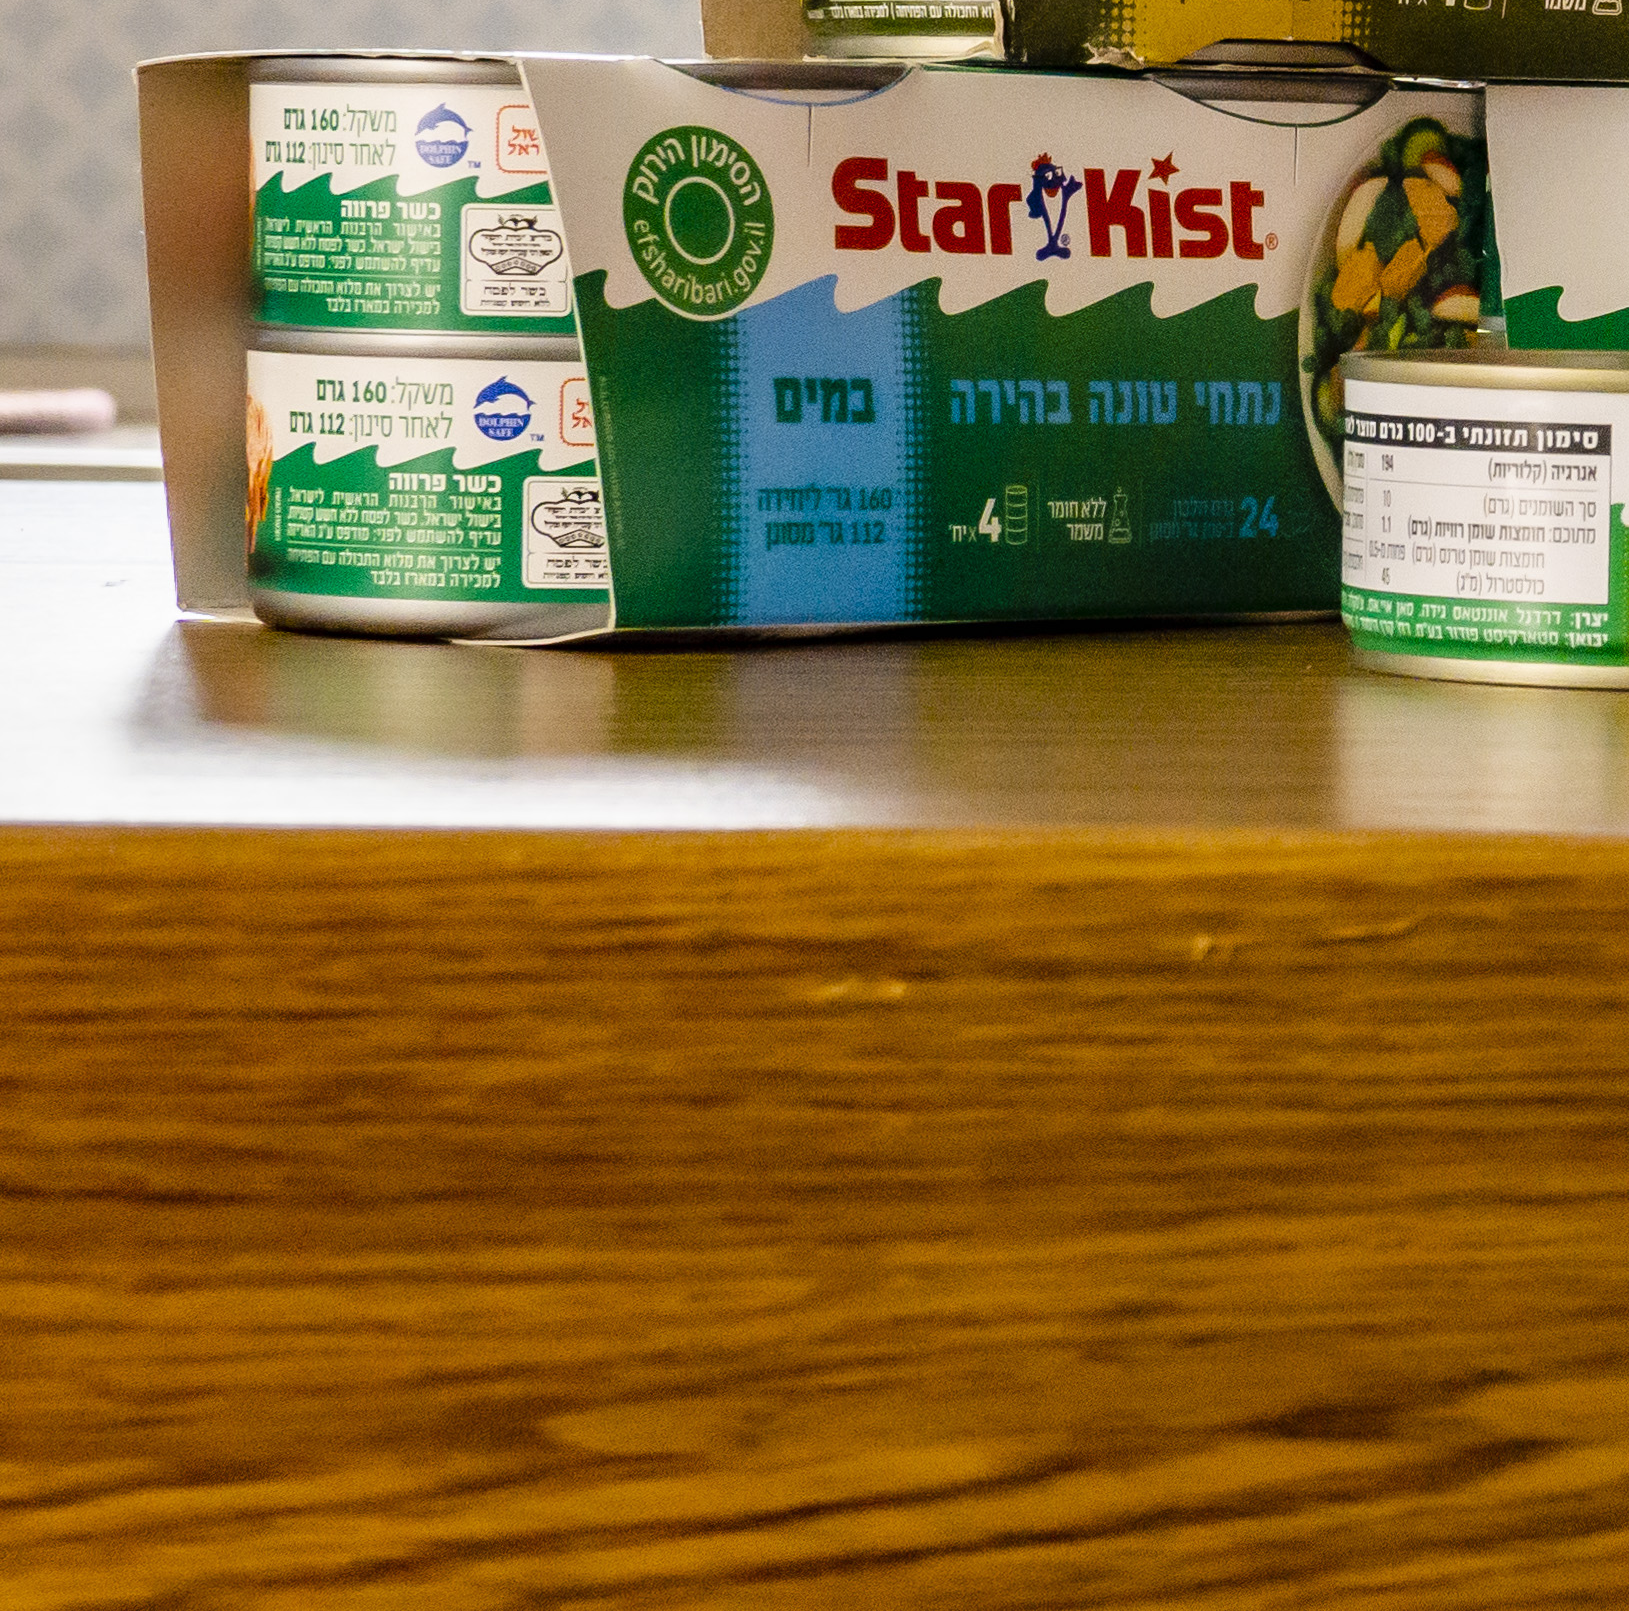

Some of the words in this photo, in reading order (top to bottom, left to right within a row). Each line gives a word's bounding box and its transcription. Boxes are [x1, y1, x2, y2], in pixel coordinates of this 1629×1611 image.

[284, 108, 305, 130] גרם
[312, 109, 339, 131] 160
[343, 104, 396, 137] משקל:
[286, 141, 305, 163] 112
[349, 138, 396, 166] לאחר
[633, 138, 685, 204] הירוק
[692, 135, 761, 206] הסימון
[341, 200, 390, 219] פרווה
[397, 202, 440, 220] כשר
[317, 379, 345, 401] גרם
[352, 381, 386, 403] 160
[391, 376, 453, 411] משקל:
[773, 377, 876, 424] במים
[950, 379, 1072, 424] בהירה
[1088, 380, 1177, 425] טונה
[1194, 381, 1282, 425] נתחי
[290, 411, 313, 433] גרם
[320, 413, 344, 435] 112
[350, 414, 392, 442] סינון:
[399, 411, 452, 438] לאחר
[1380, 422, 1403, 440] גרם
[1408, 423, 1456, 443] ב-100
[1463, 427, 1528, 446] תזונתי
[1537, 430, 1598, 451] סימון
[1488, 458, 1547, 484] (קלוריות)
[1551, 464, 1597, 481] אנרגיה
[389, 473, 446, 491] פרווה
[453, 475, 501, 493] כשר
[389, 494, 437, 509] הרבנות
[449, 496, 501, 511] באישור
[758, 483, 821, 511] ליחידה
[859, 489, 892, 510] 160
[1081, 497, 1106, 519] ללא
[1239, 496, 1278, 538] 24
[1519, 500, 1574, 516] השומנים
[1579, 502, 1597, 522] סך
[407, 529, 464, 544] להשתמש
[469, 531, 501, 548] עדיף
[765, 522, 815, 551] מסונן
[851, 521, 884, 544] 112
[1066, 522, 1103, 541] משמר
[1468, 523, 1495, 543] שומן
[1499, 525, 1545, 542] חומצות
[440, 553, 479, 573] לצרוך
[484, 557, 501, 570] יש
[1470, 550, 1496, 569] שומן
[1499, 551, 1544, 568] חומצות
[405, 572, 445, 587] במארז
[451, 572, 500, 588] למכירה
[1486, 573, 1544, 595] כולסטרול
[1516, 608, 1561, 625] דרדנל
[1484, 629, 1559, 645] סטארקיסט
